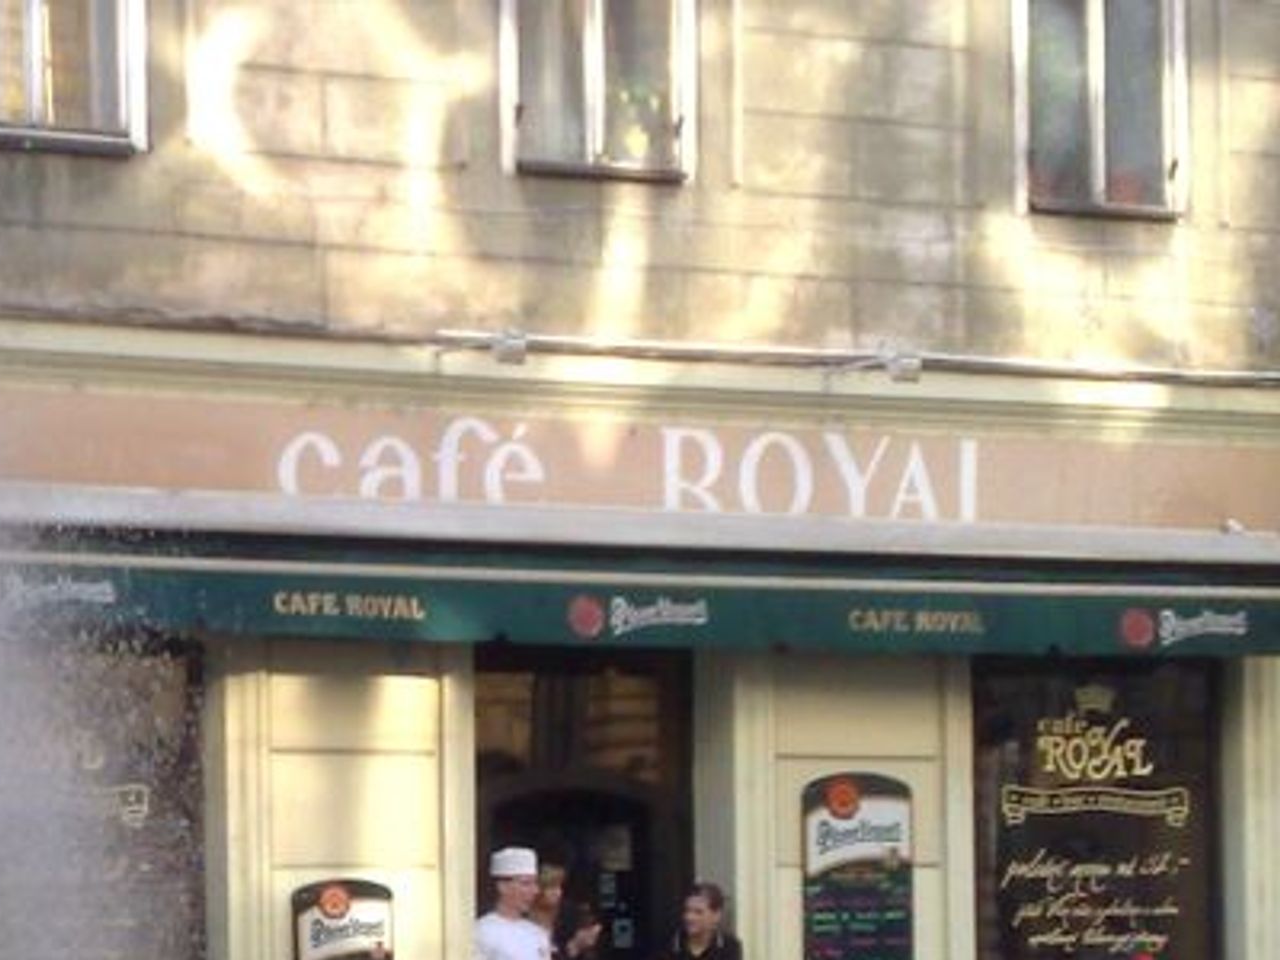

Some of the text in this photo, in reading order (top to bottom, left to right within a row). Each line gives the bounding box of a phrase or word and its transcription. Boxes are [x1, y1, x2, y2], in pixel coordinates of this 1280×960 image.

[277, 416, 545, 502] café
[345, 592, 427, 621] ROYAL
[914, 609, 986, 634] ROYAL
[1036, 718, 1155, 780] ROYAL
